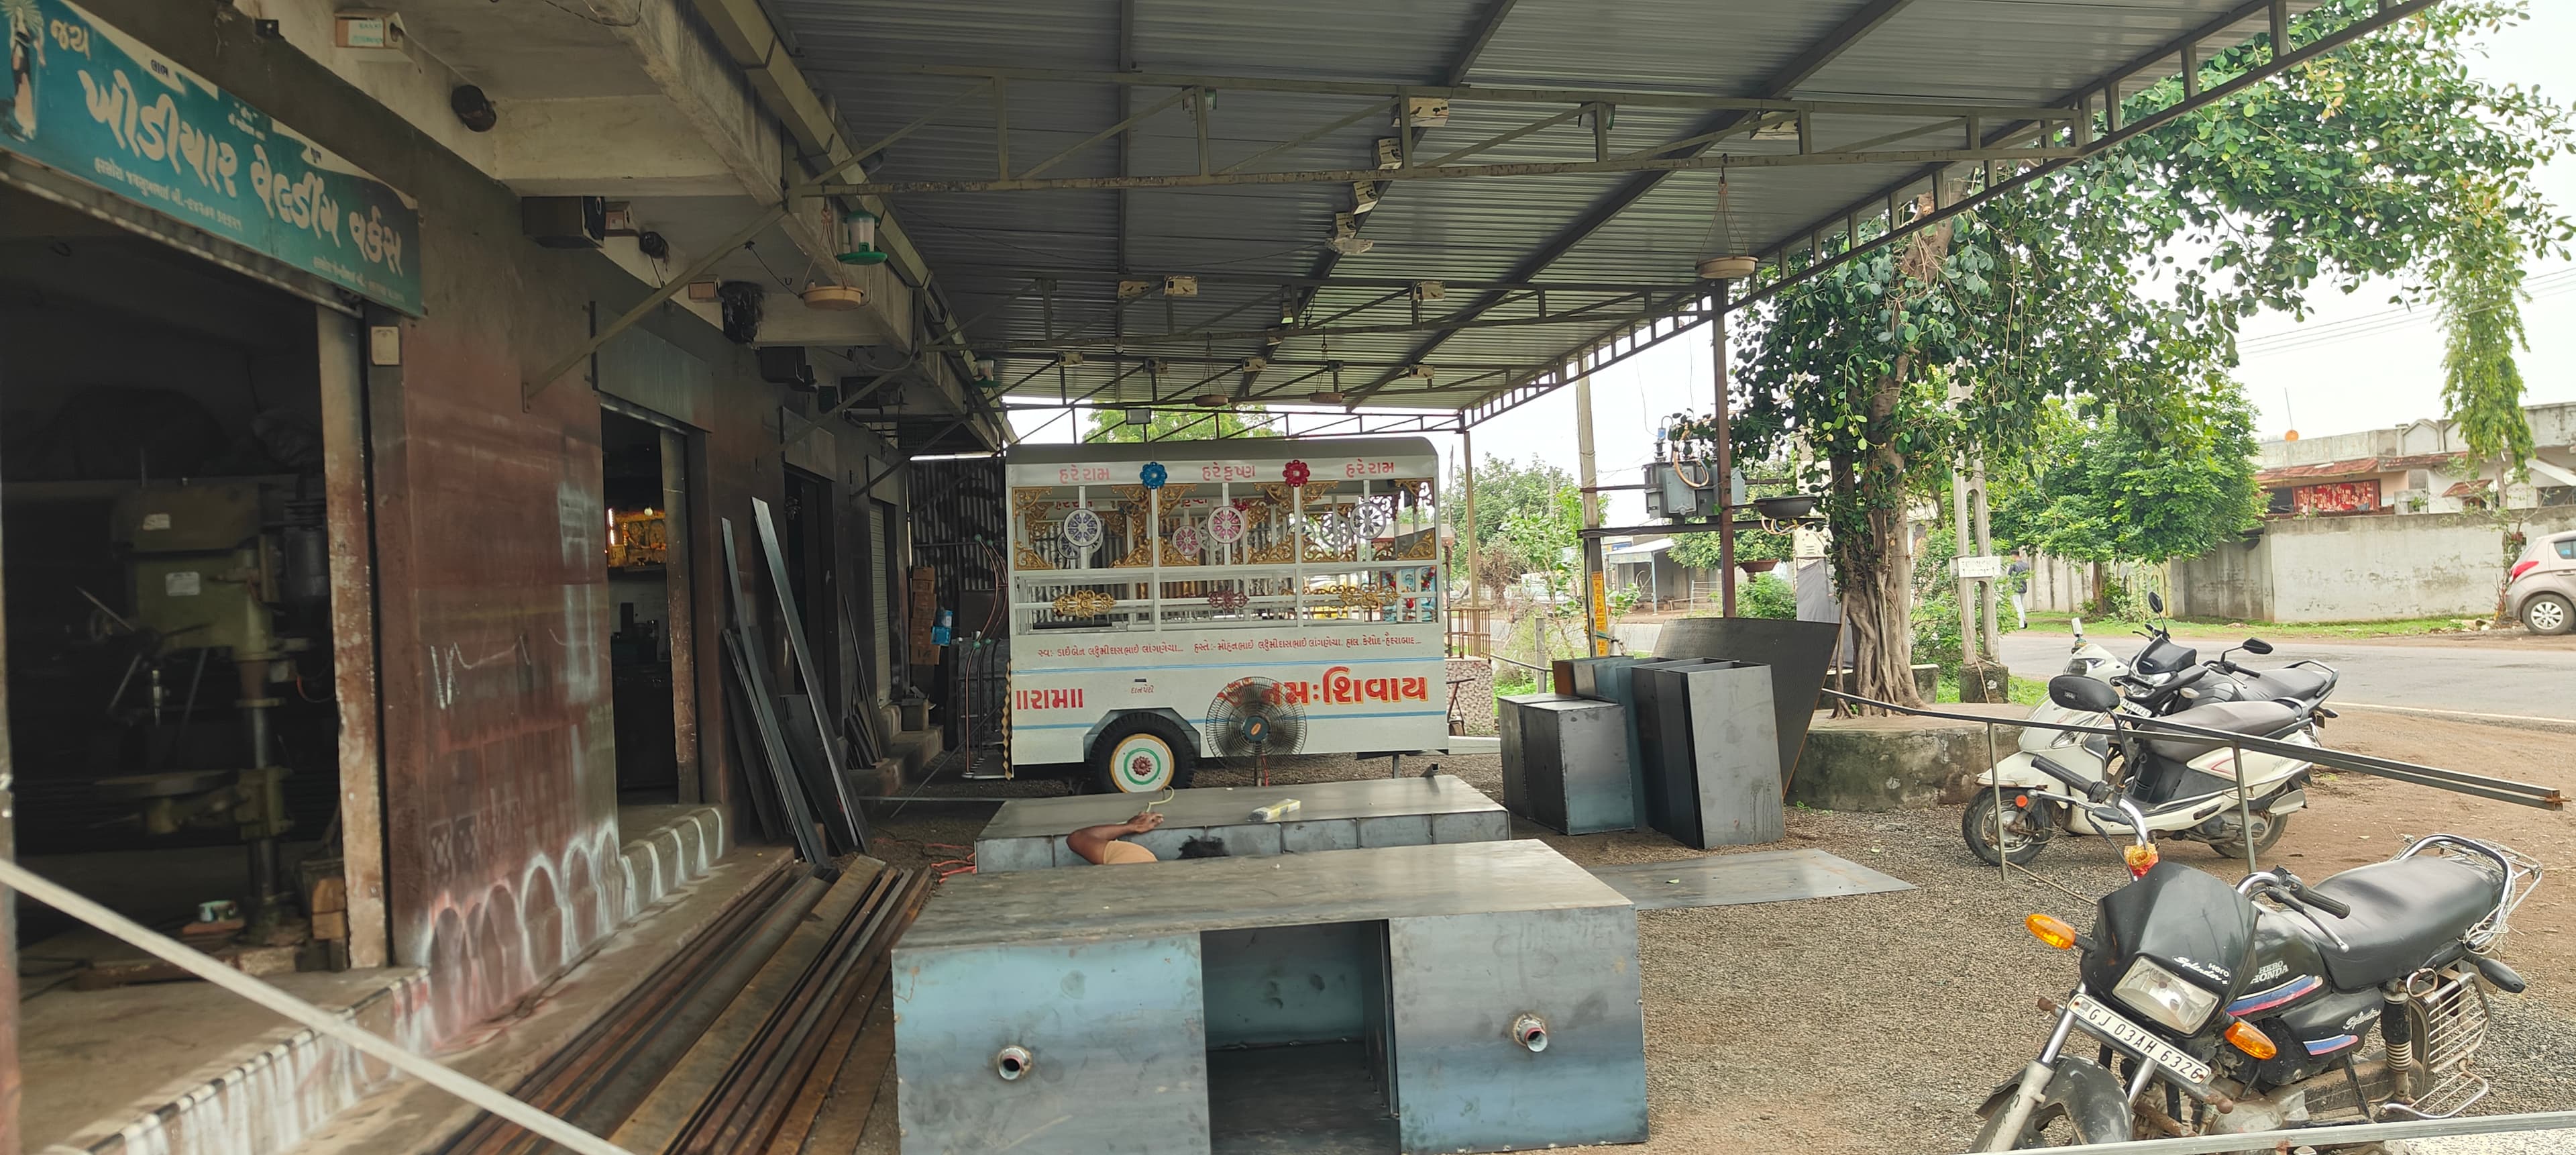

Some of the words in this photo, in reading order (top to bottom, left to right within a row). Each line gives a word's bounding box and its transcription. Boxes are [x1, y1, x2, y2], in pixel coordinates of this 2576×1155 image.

[50, 19, 91, 60] જય
[78, 69, 237, 197] ખોડીયાર
[2250, 965, 2289, 984] HONDA
[2259, 960, 2284, 974] HERO
[2089, 1009, 2112, 1026] GJ
[2114, 1024, 2158, 1054] 03AH
[2159, 1050, 2203, 1079] 6326
